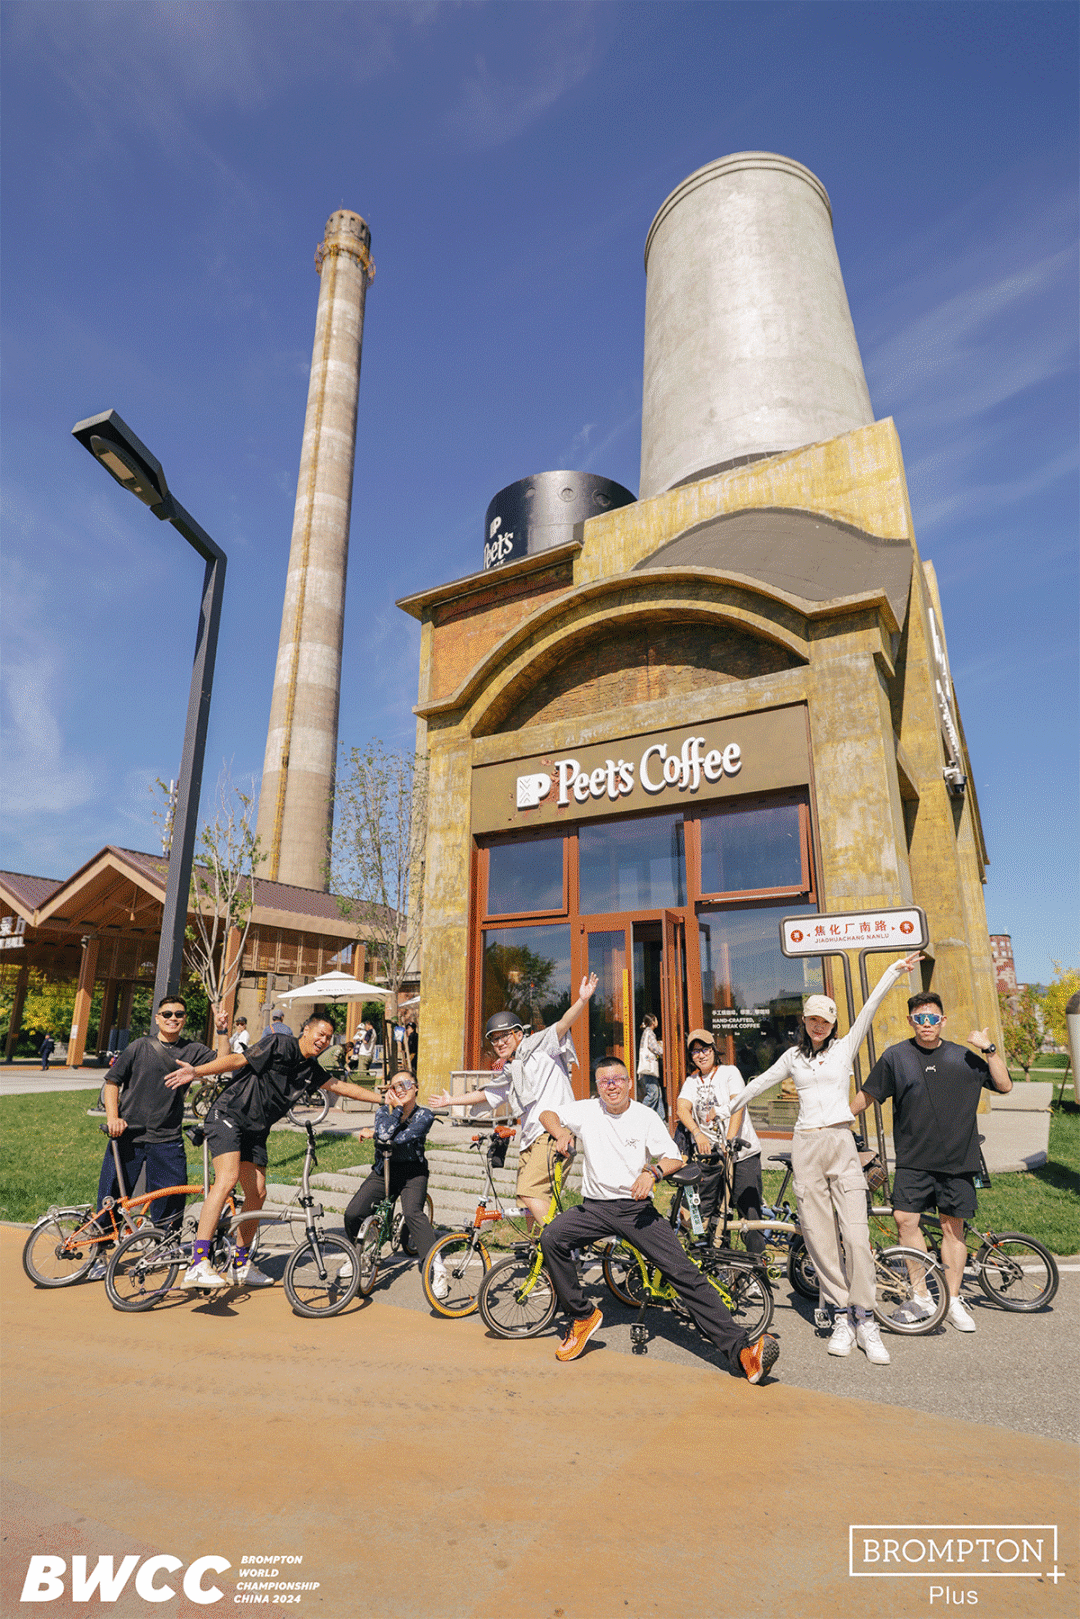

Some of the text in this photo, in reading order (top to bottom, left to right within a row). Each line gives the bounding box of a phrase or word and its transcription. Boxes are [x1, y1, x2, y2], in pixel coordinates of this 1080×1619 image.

[554, 757, 635, 806] Peet's
[639, 735, 743, 793] Coffee
[814, 920, 888, 937] 焦化厂南路
[814, 935, 866, 944] JIAOHUACHANG
